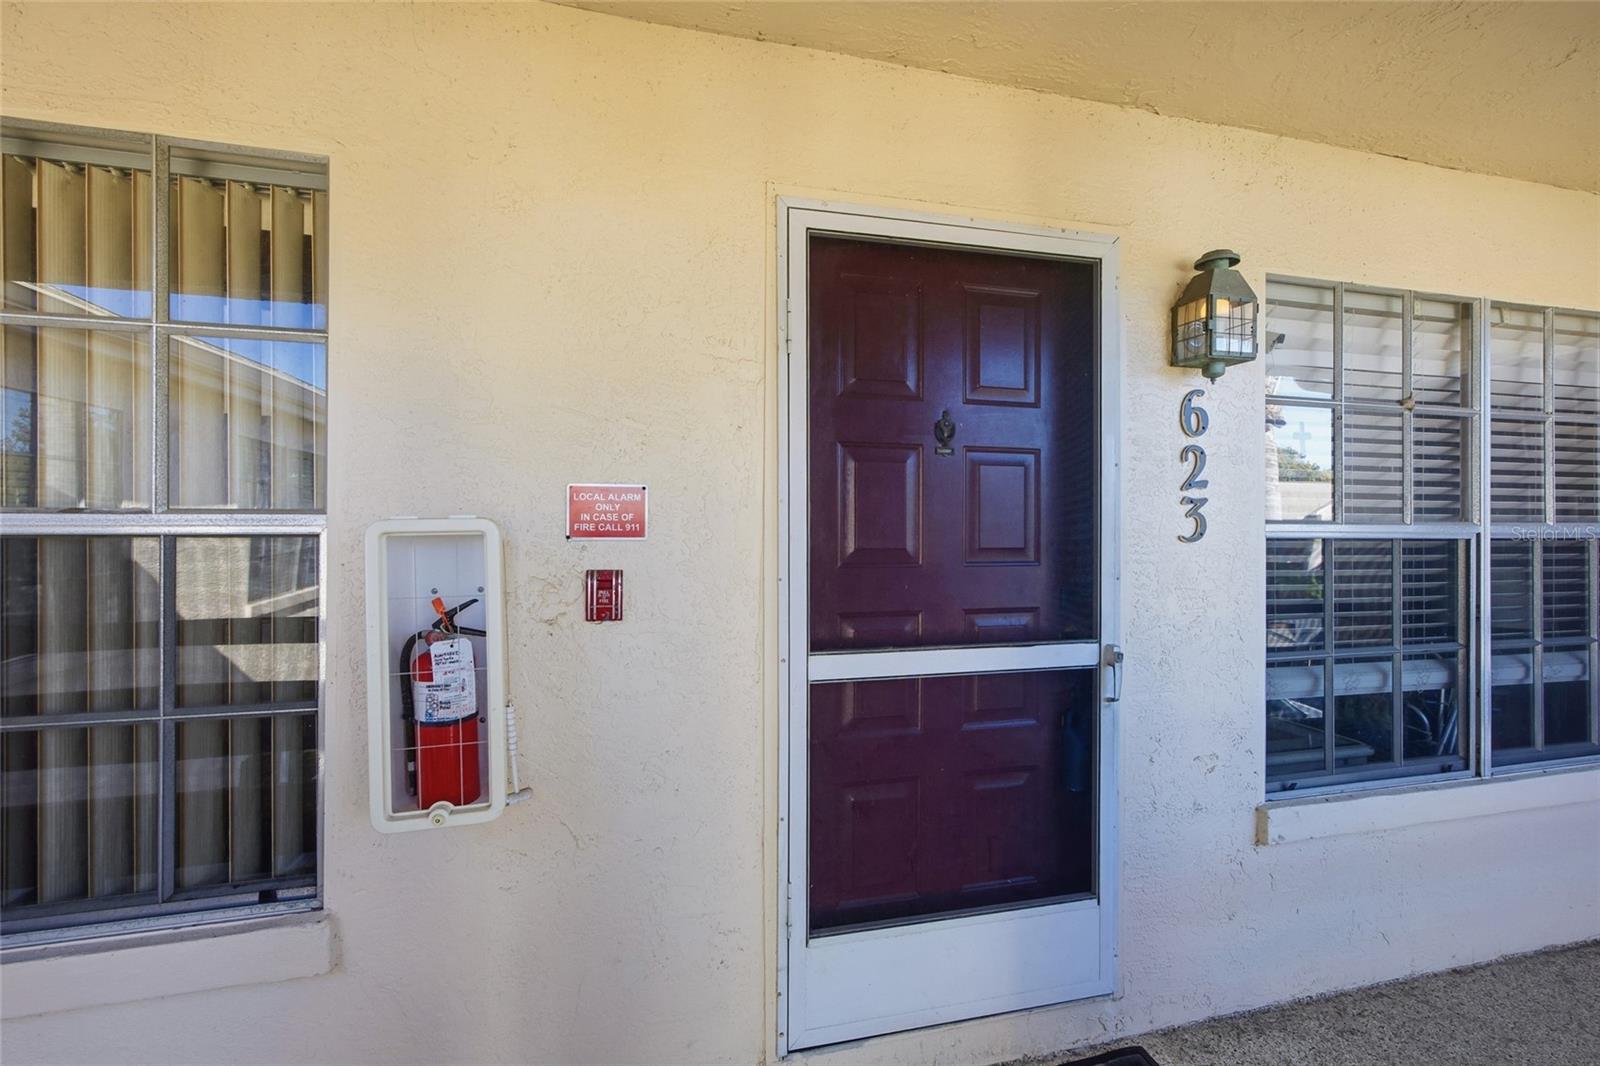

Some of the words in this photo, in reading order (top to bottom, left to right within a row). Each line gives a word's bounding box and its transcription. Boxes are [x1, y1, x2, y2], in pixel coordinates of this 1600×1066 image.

[1178, 389, 1209, 543] 623
[573, 493, 606, 501] LOCAL
[608, 493, 641, 501] ALARM
[595, 503, 621, 511] ONLY
[580, 513, 591, 521] IN
[592, 513, 619, 521] CASE
[621, 513, 635, 521] OF
[574, 523, 596, 531] FIRE
[598, 523, 623, 531] CALL
